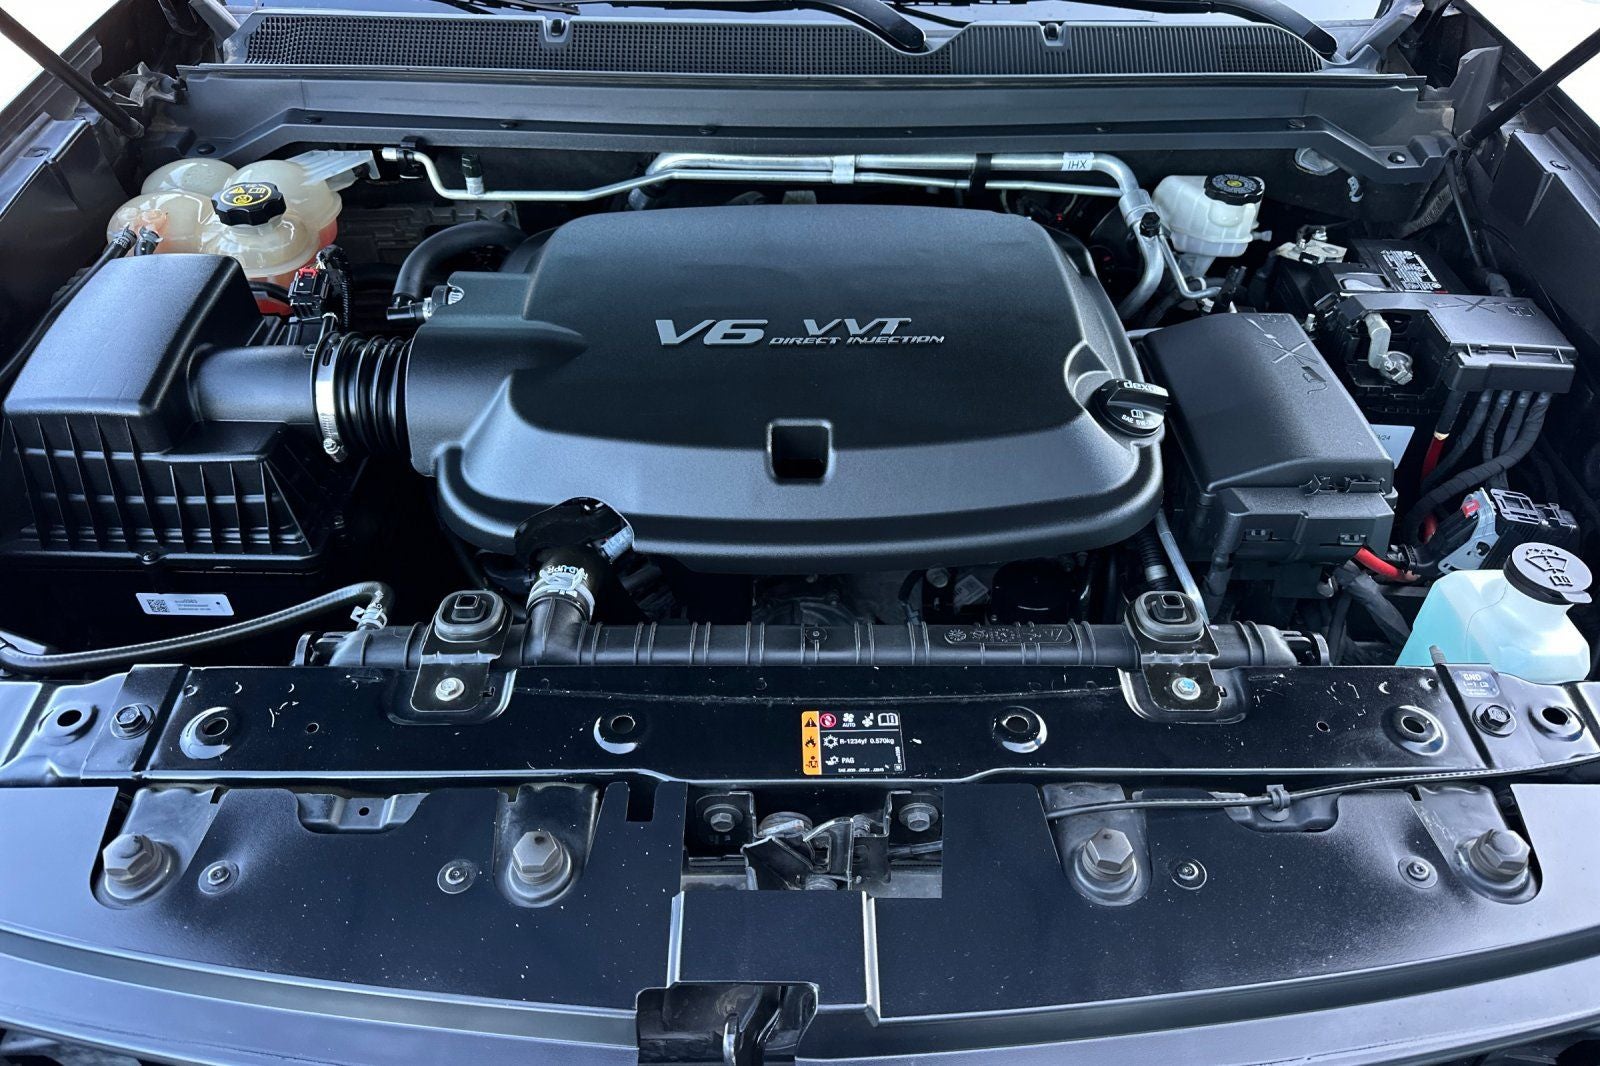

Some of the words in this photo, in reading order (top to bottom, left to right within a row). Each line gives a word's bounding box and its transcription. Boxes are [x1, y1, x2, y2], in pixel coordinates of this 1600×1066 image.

[1067, 159, 1087, 170] IHX
[655, 319, 769, 346] V6
[803, 317, 912, 336] VVT
[769, 336, 841, 345] DIRECT
[846, 335, 945, 345] INJECTION
